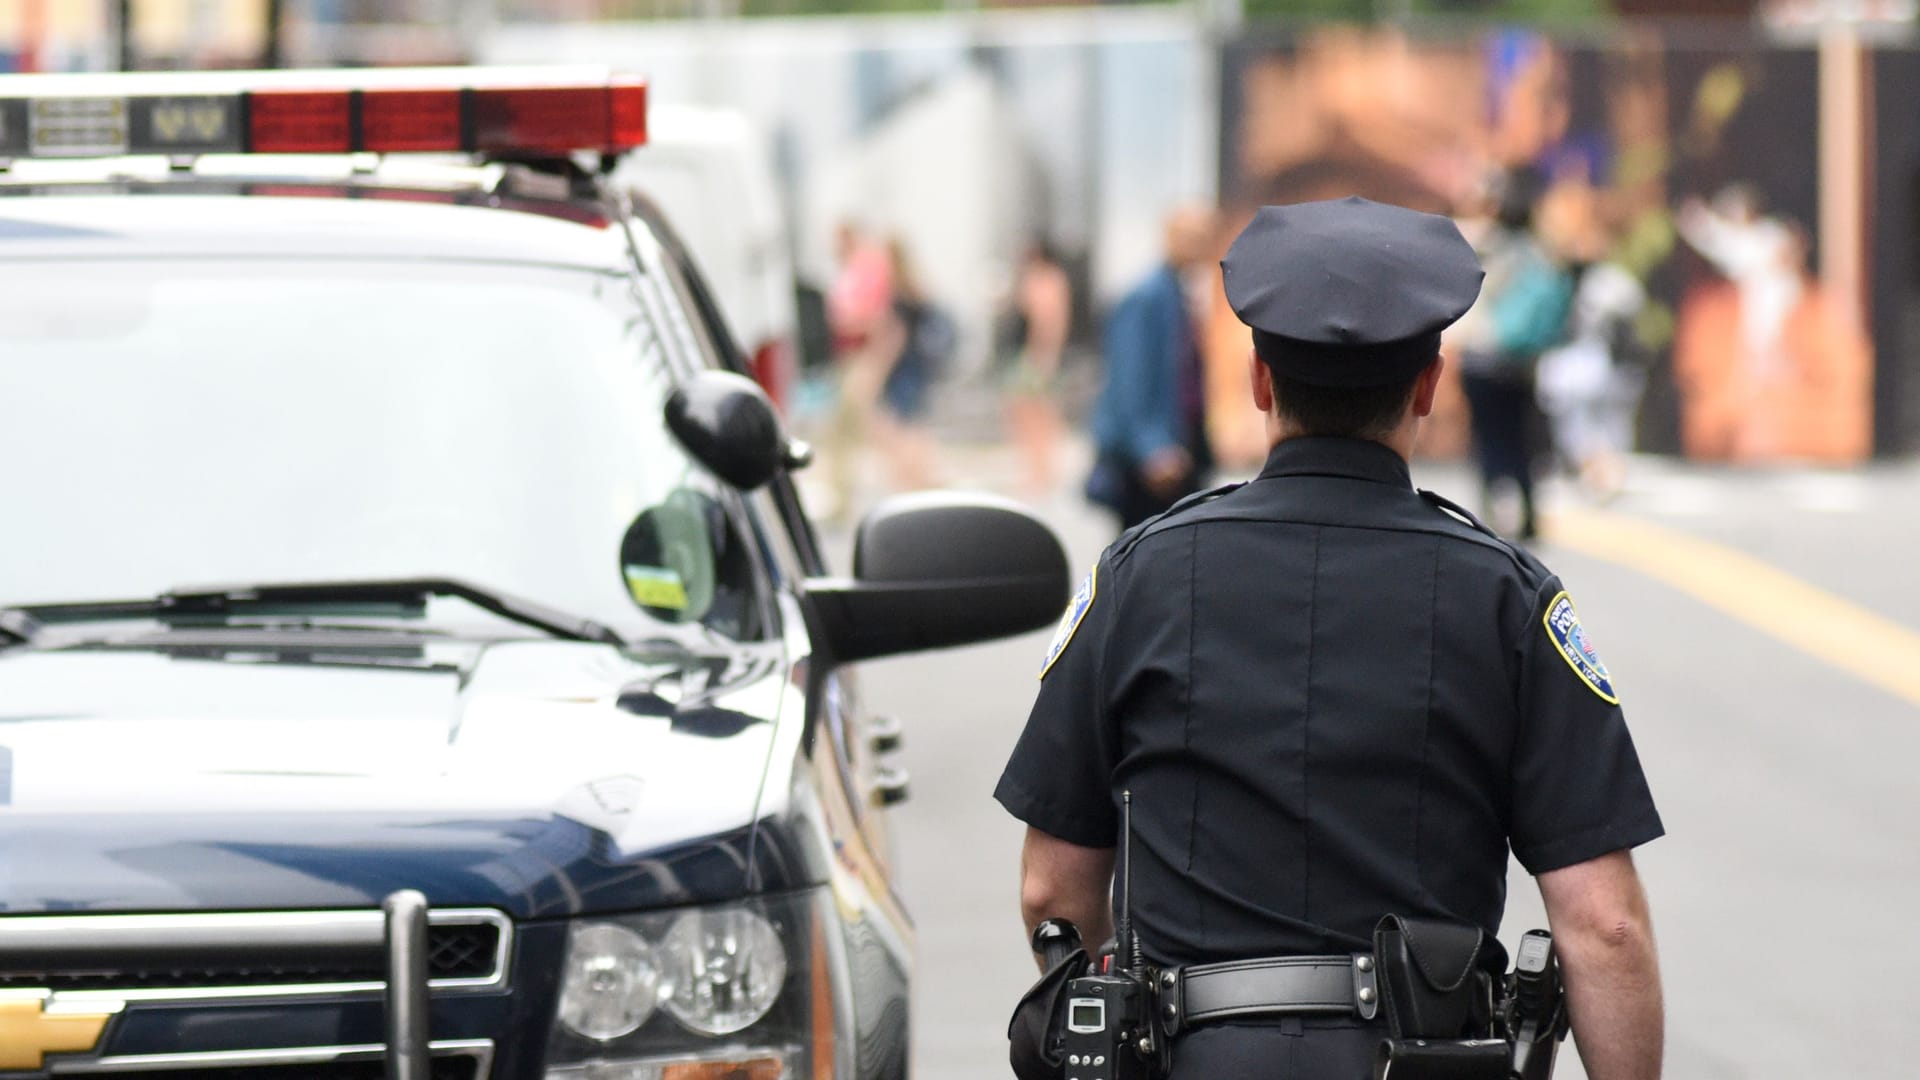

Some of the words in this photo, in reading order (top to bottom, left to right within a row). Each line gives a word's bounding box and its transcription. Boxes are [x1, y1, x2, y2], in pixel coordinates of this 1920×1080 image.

[1557, 608, 1576, 634] POLI
[1563, 643, 1581, 664] NEW
[1583, 664, 1601, 688] YORK
